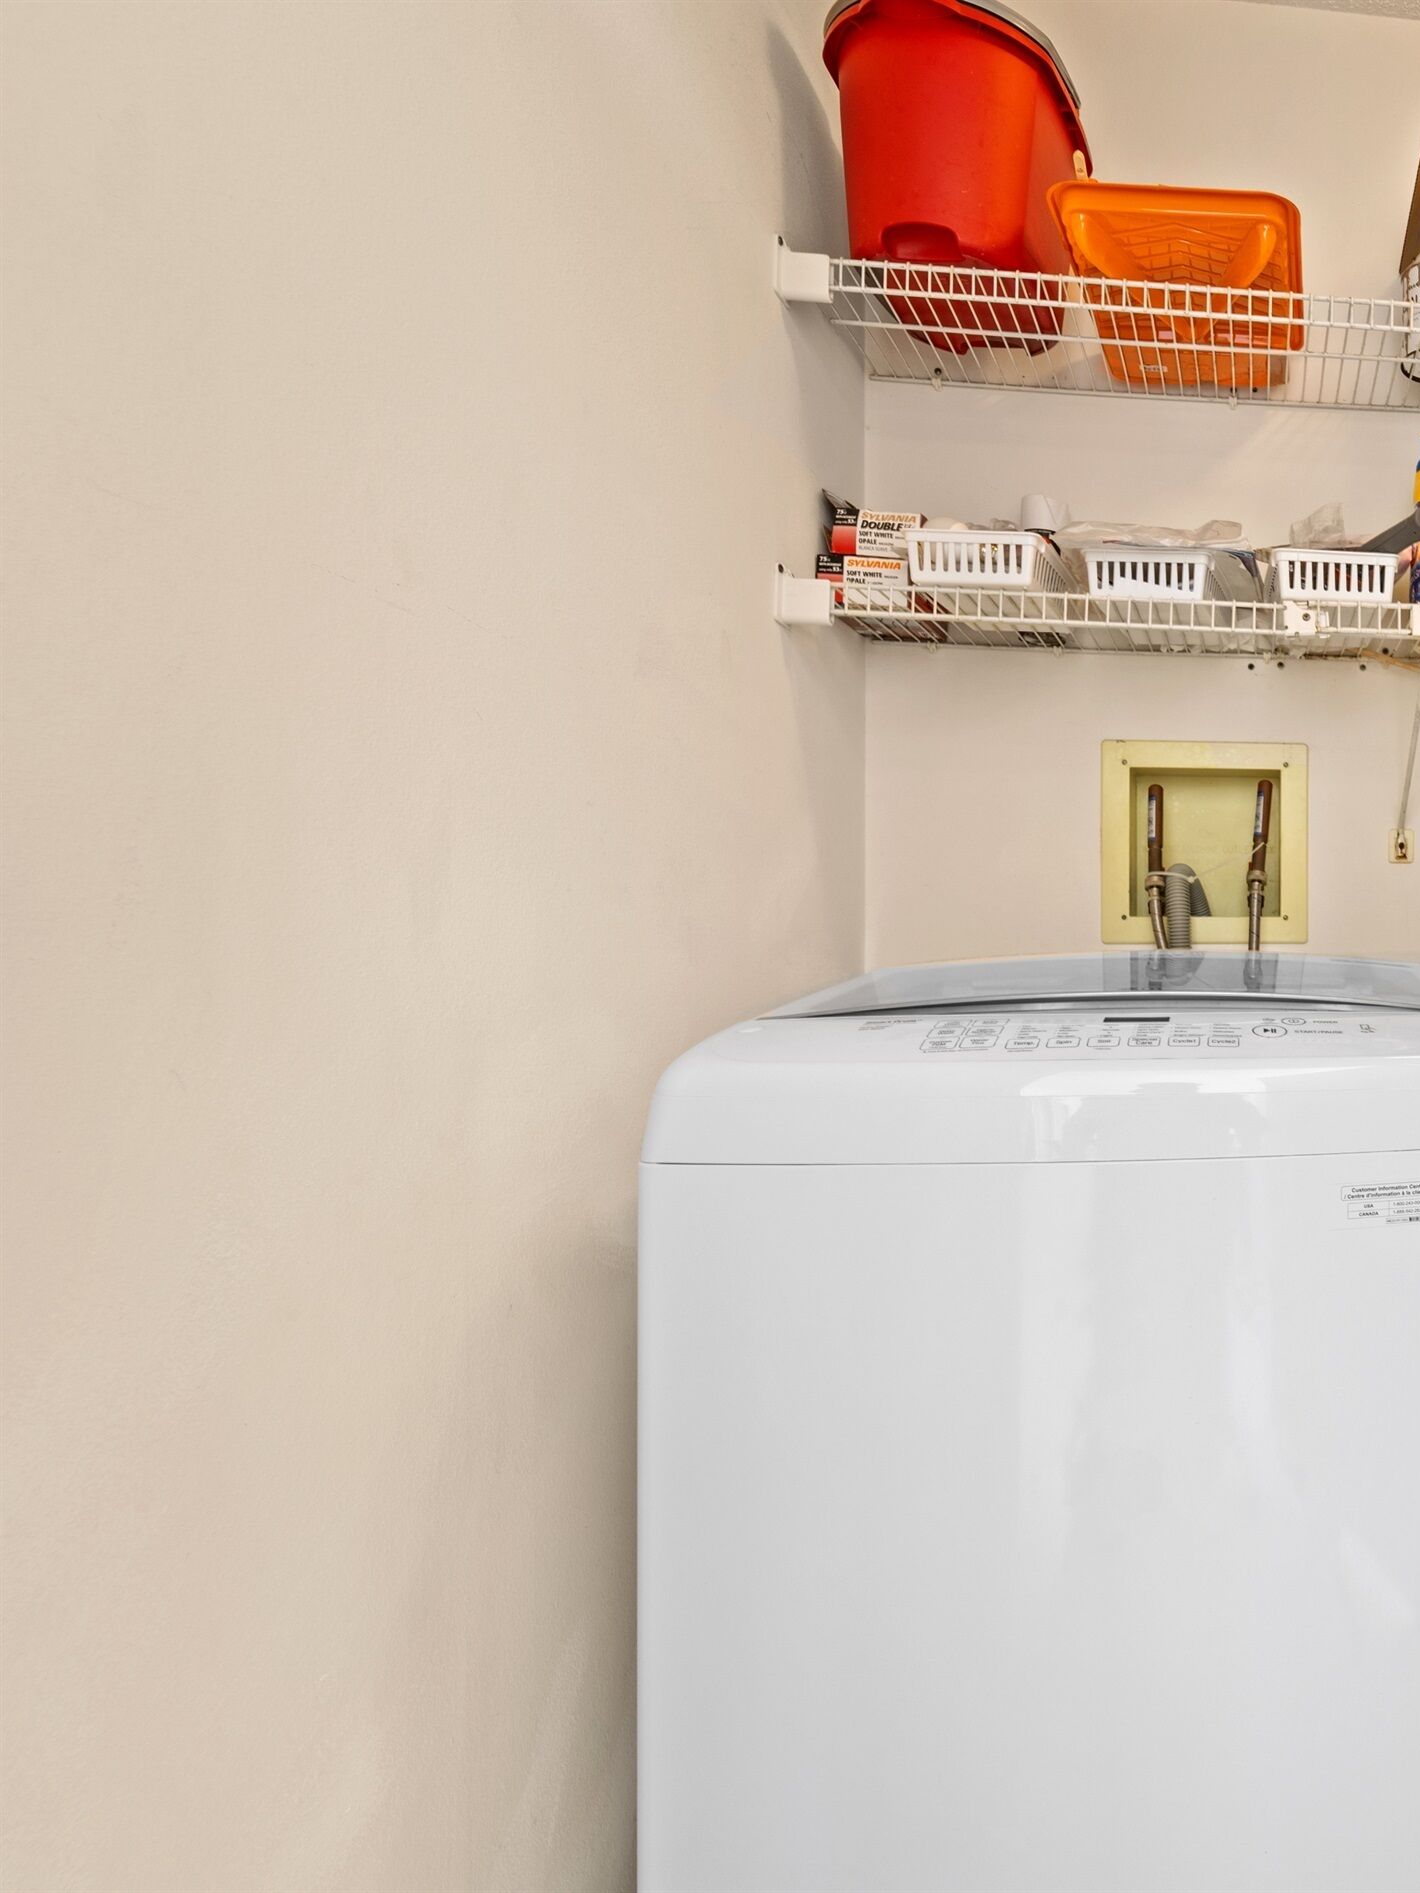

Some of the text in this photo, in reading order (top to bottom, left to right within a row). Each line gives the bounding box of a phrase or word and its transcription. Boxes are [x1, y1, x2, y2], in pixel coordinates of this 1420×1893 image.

[861, 511, 917, 524] SYLVANIA
[860, 519, 904, 532] DOUBLE
[874, 531, 893, 539] WHITE
[847, 559, 902, 571] SYLVANIA
